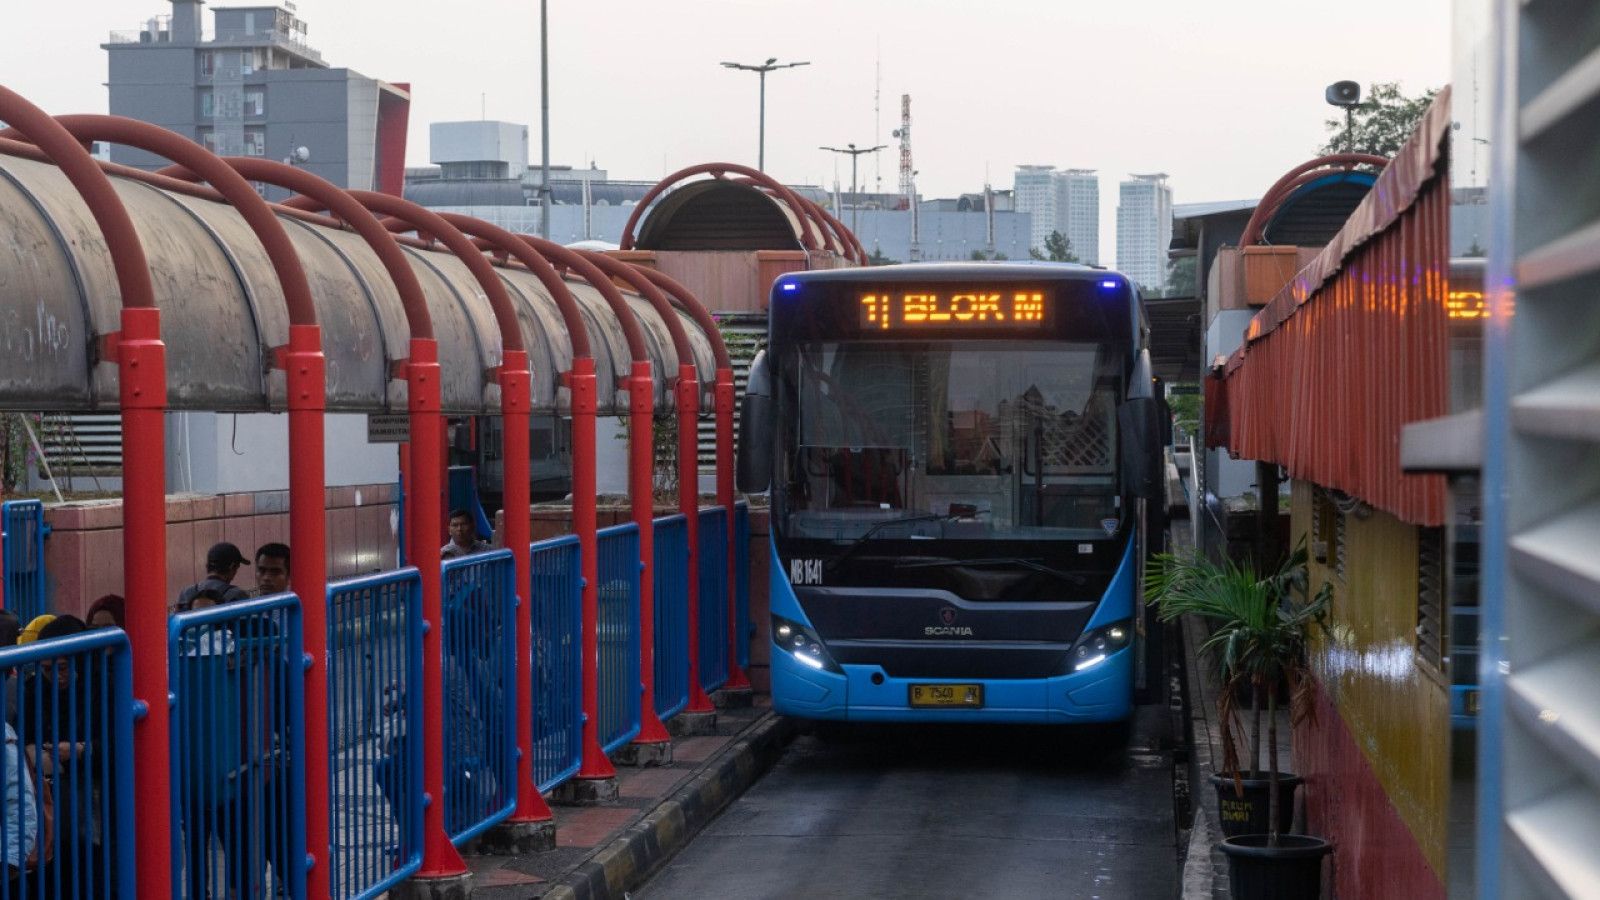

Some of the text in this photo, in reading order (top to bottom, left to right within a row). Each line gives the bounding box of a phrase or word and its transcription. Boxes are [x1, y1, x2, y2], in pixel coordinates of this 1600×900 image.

[904, 294, 1004, 321] BLOK
[1014, 294, 1042, 321] M
[924, 626, 973, 636] SCANIA
